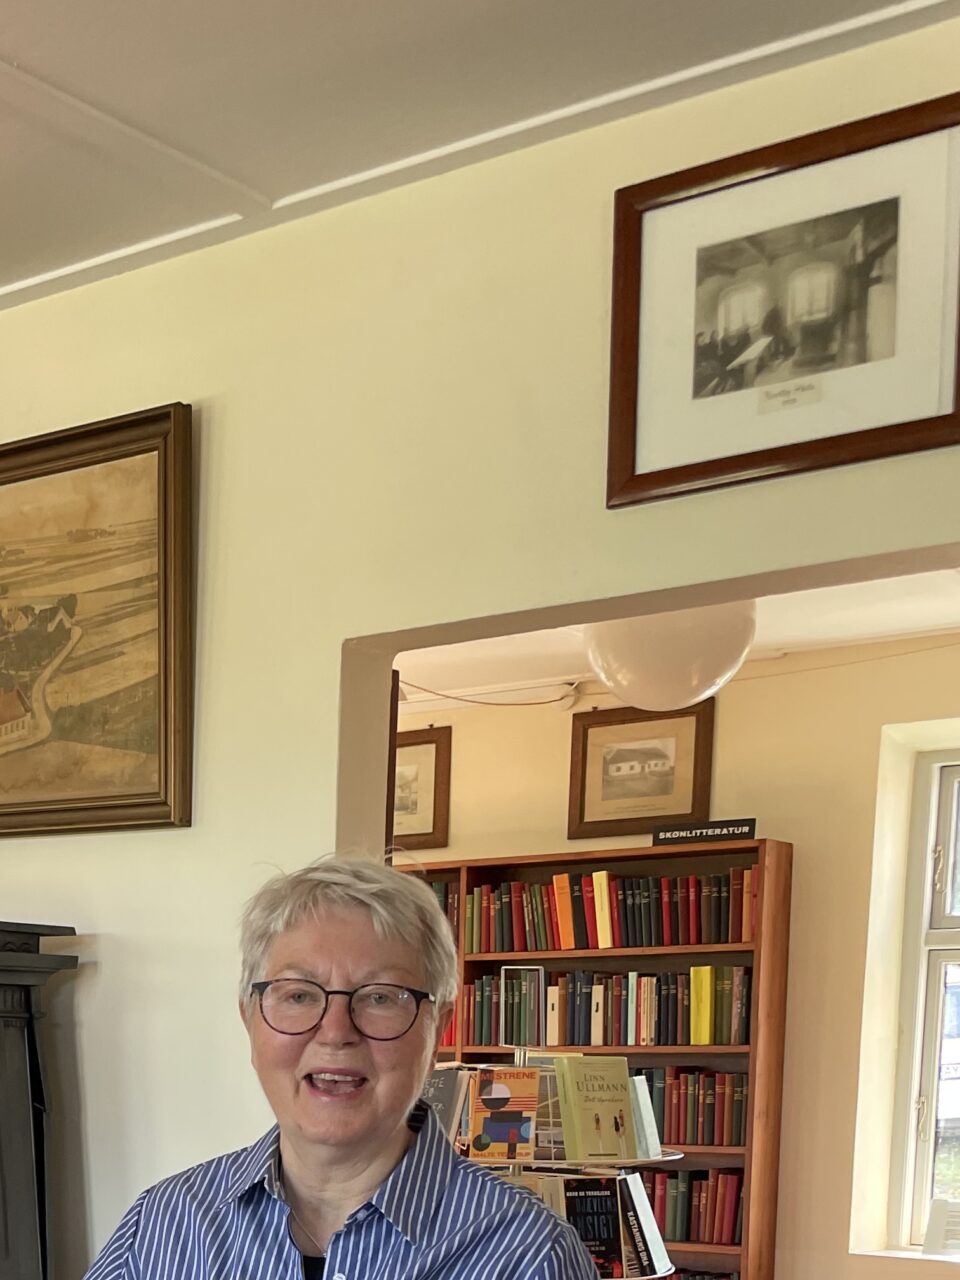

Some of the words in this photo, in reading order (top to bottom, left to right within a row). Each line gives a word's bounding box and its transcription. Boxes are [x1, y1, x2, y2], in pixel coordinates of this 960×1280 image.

[658, 826, 750, 839] SKØNLITTERATUR
[583, 1072, 605, 1082] LINN
[576, 1080, 627, 1092] ULLMANN
